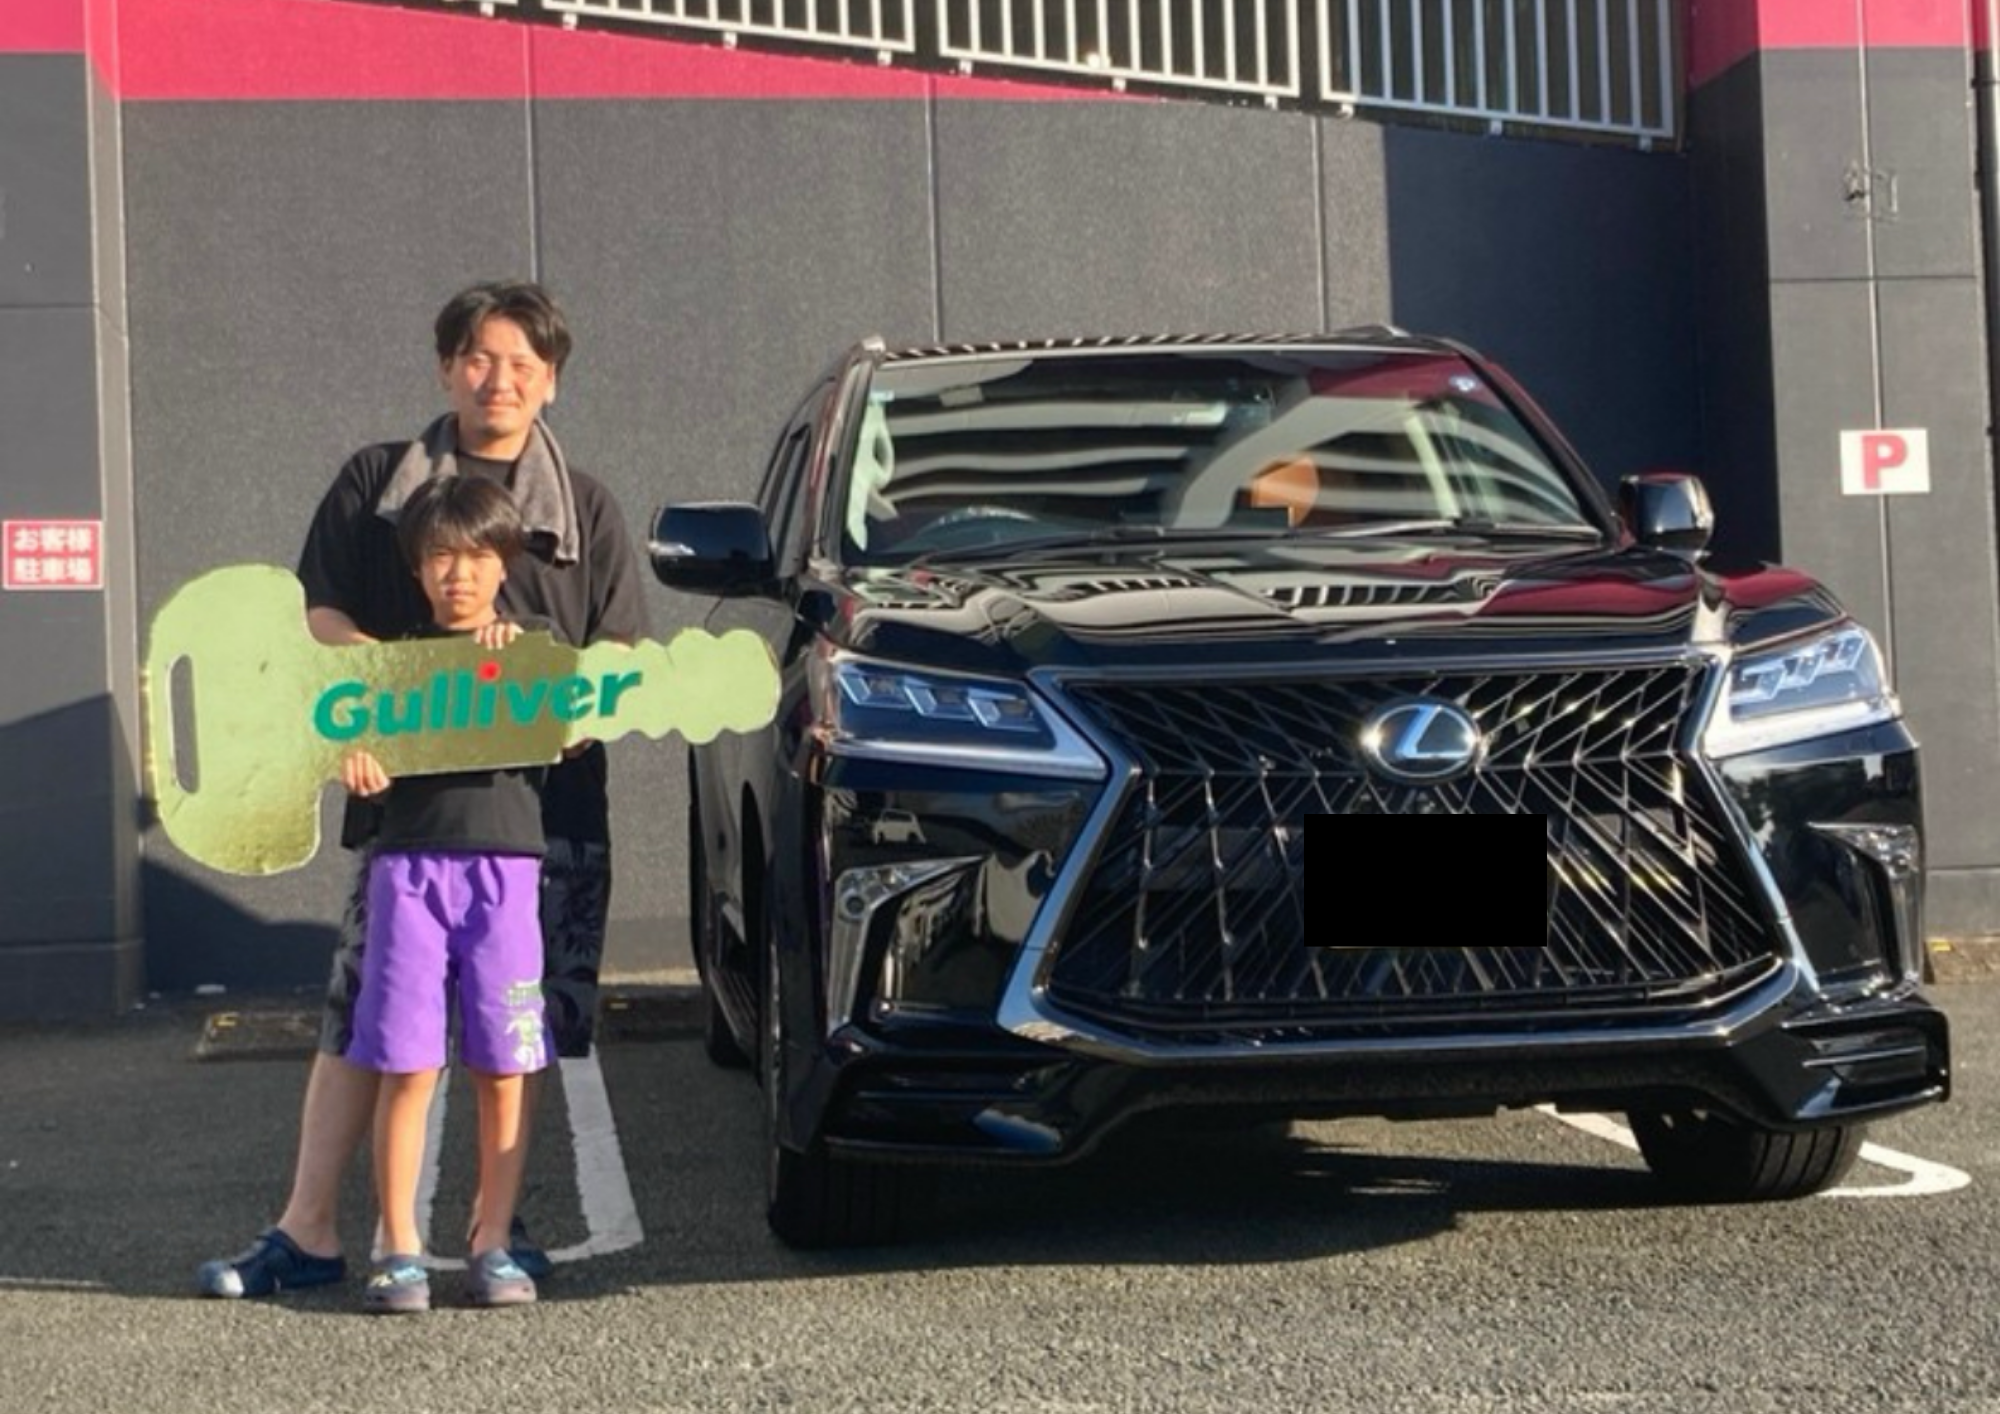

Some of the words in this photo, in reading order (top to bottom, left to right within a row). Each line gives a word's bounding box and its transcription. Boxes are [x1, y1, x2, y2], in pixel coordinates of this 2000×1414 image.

[1862, 434, 1908, 490] P
[13, 526, 92, 554] お客様
[14, 556, 92, 583] 駐車場
[313, 660, 643, 741] Gulliver
